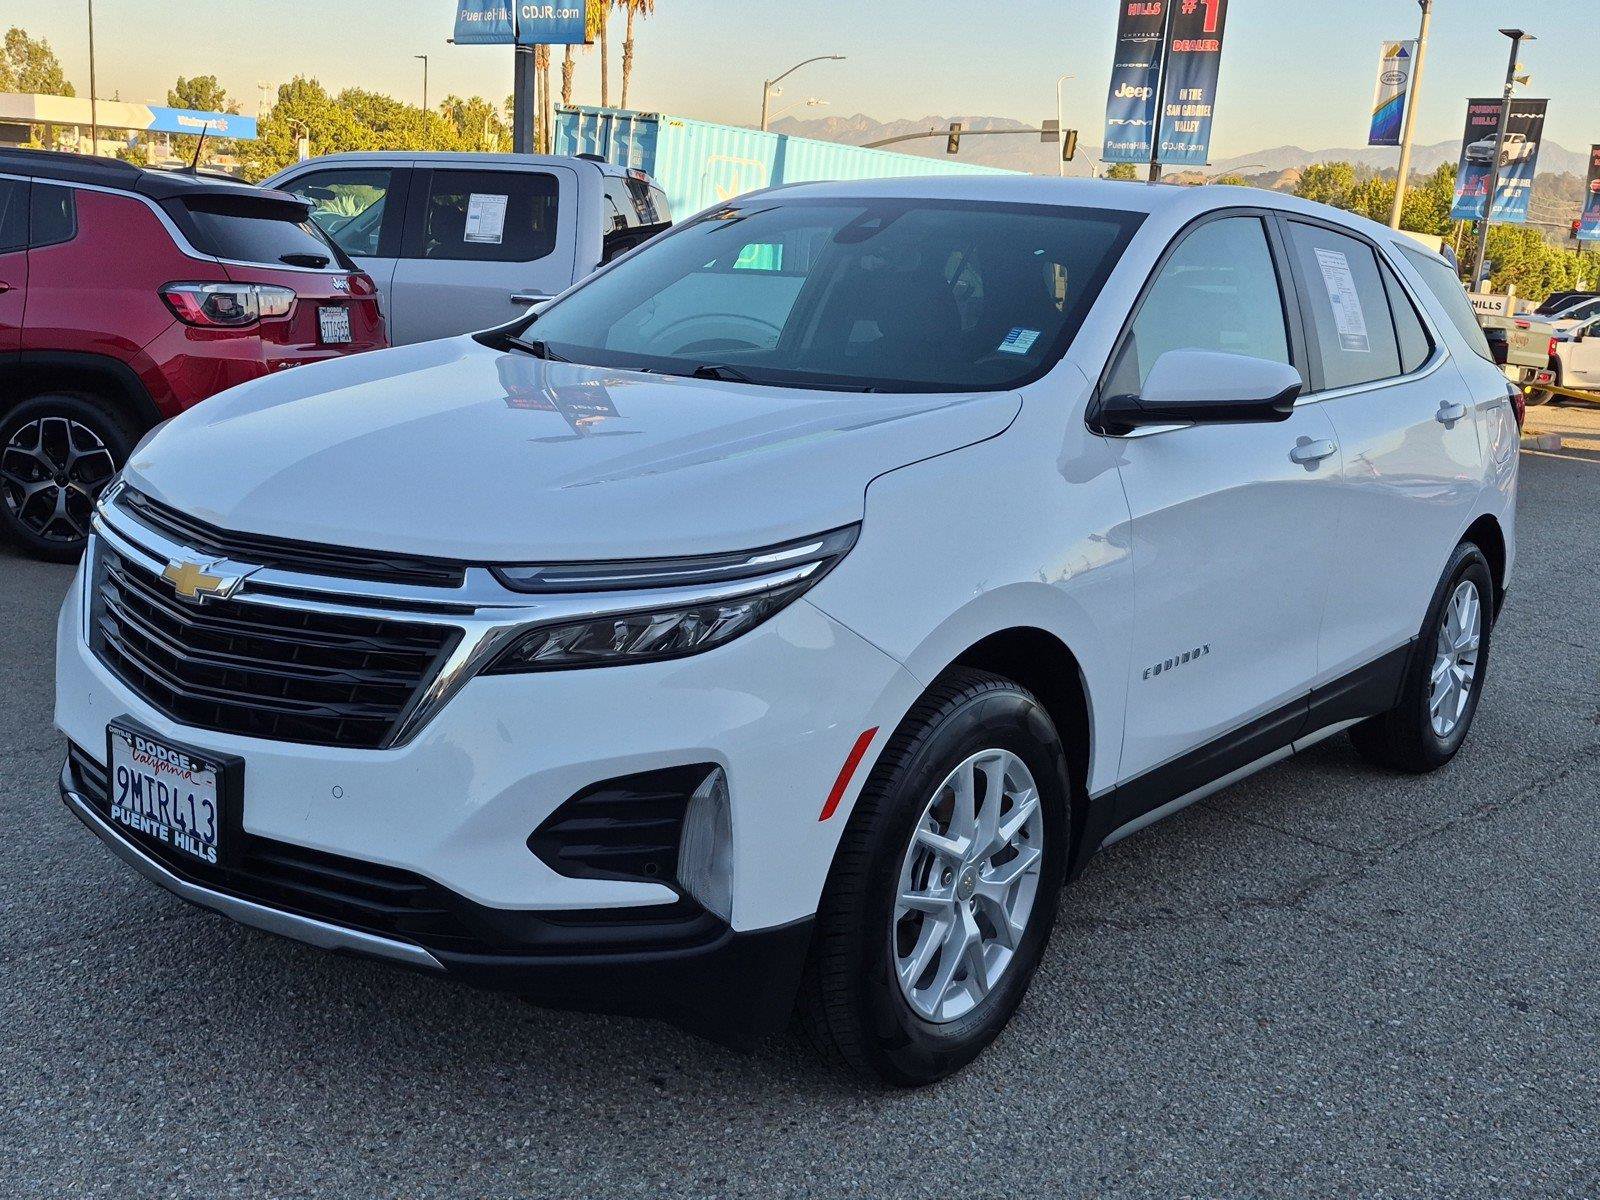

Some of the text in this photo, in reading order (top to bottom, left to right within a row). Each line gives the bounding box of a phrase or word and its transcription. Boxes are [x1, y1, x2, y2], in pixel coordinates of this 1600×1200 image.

[522, 5, 580, 19] CDJR.com
[1128, 2, 1161, 15] HILLS
[1181, 0, 1220, 32] #1
[1172, 39, 1219, 51] DEALER
[1114, 83, 1152, 101] Jeep
[1180, 88, 1203, 100] IN THE
[1166, 104, 1211, 117] SAN GABRIEL
[1469, 105, 1502, 114] PUENT
[1175, 120, 1200, 132] VALLEY
[1107, 140, 1150, 150] PuenteHills
[1161, 141, 1204, 151] CDJR.com
[1472, 300, 1502, 311] HILLS
[1142, 643, 1211, 680] EQUINOX
[135, 737, 191, 770] DODGE
[132, 746, 201, 785] California
[117, 765, 216, 845] 9MIR413
[111, 805, 218, 864] PUENTE HILLS
